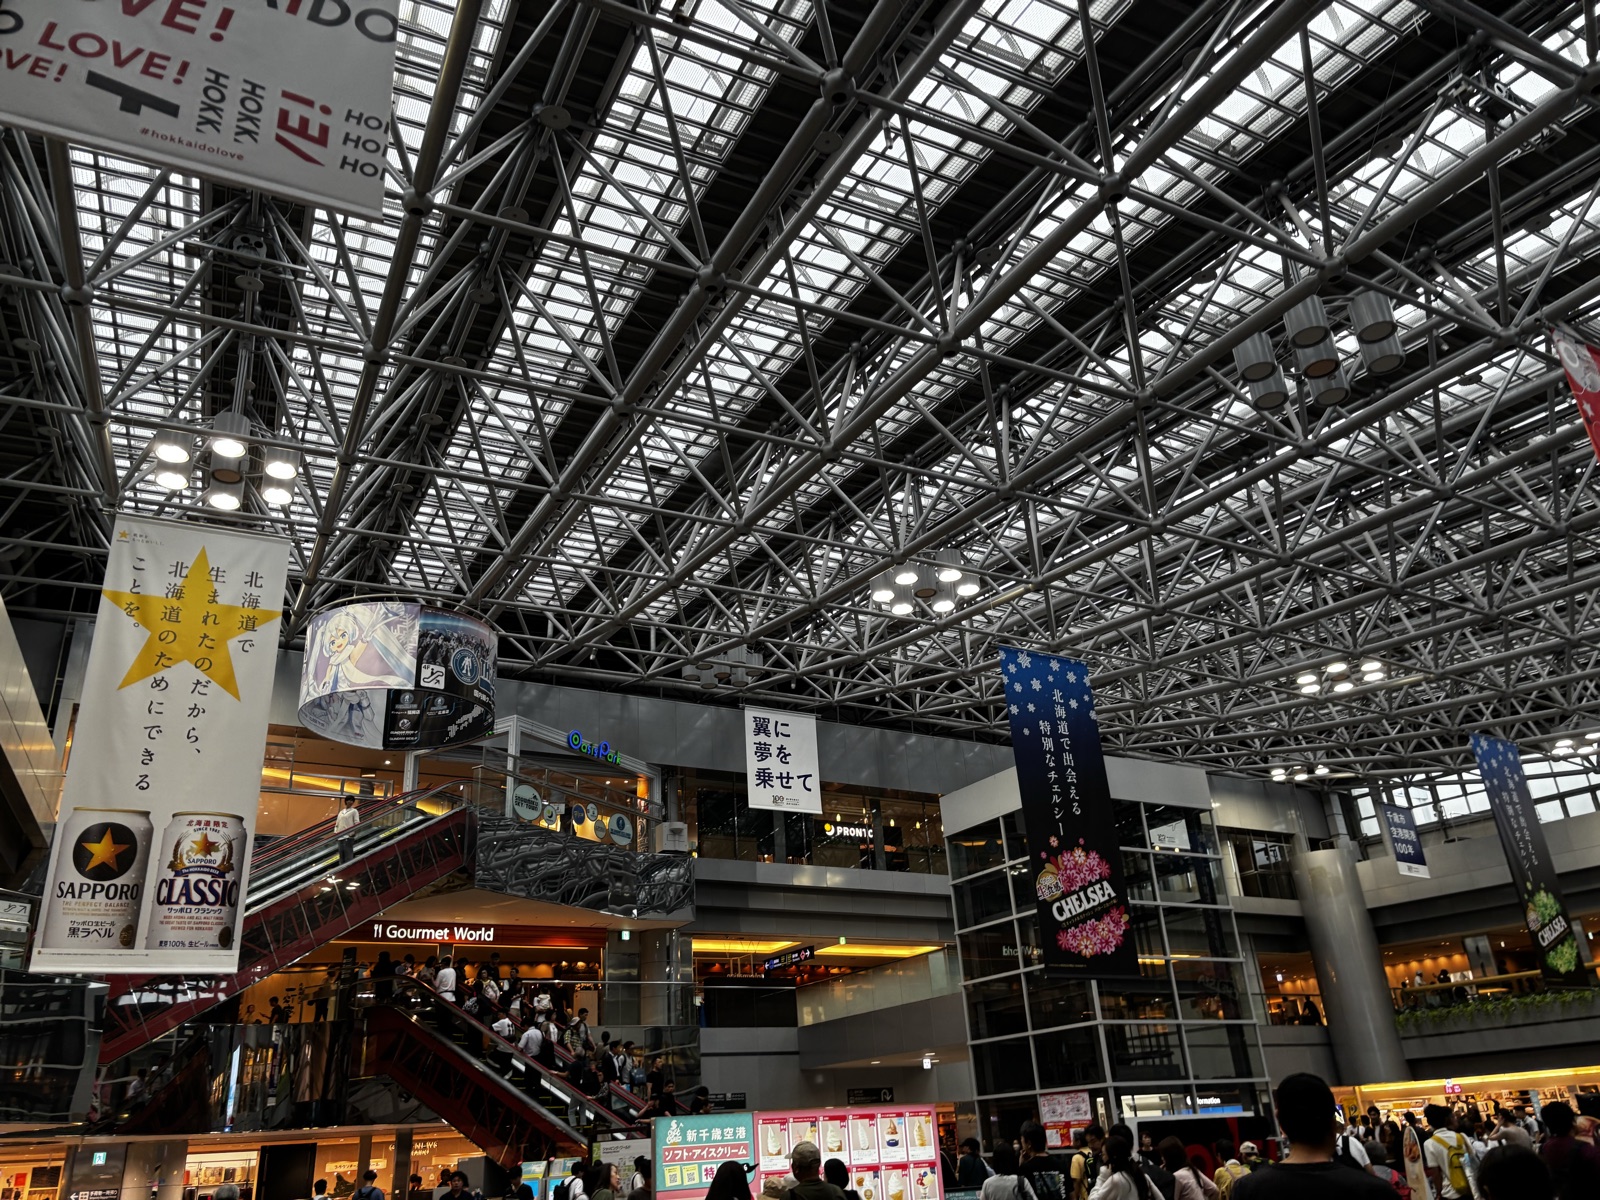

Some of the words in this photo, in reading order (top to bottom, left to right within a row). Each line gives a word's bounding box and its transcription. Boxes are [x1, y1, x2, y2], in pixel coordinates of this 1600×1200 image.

[0, 48, 69, 84] VE!
[38, 22, 190, 85] LOVE!
[139, 127, 245, 161] #hokkaidolove
[123, 556, 147, 628] ことを。
[237, 571, 264, 653] 北海道で
[135, 560, 189, 791] 北海道のためにできる
[186, 566, 227, 754] 生まれたのだから、
[752, 716, 791, 738] 翼に
[567, 729, 599, 758] Oasis
[598, 741, 622, 765] Park
[753, 741, 792, 764] 夢を
[1052, 688, 1082, 816] 北海道で出会える
[754, 767, 813, 792] 乗せて
[1038, 720, 1065, 836] 特別なチェルシー
[1394, 842, 1415, 856] 100年
[56, 881, 139, 900] SAPPORO
[156, 878, 239, 908] CLASSIC
[1052, 880, 1117, 922] CHELSEA
[67, 927, 115, 938] 黒ラベル
[386, 924, 449, 940] Gourmet
[453, 927, 494, 942] World
[686, 1126, 747, 1143] 新千歳空港
[664, 1145, 747, 1161] ソフト・アイスクリーム
